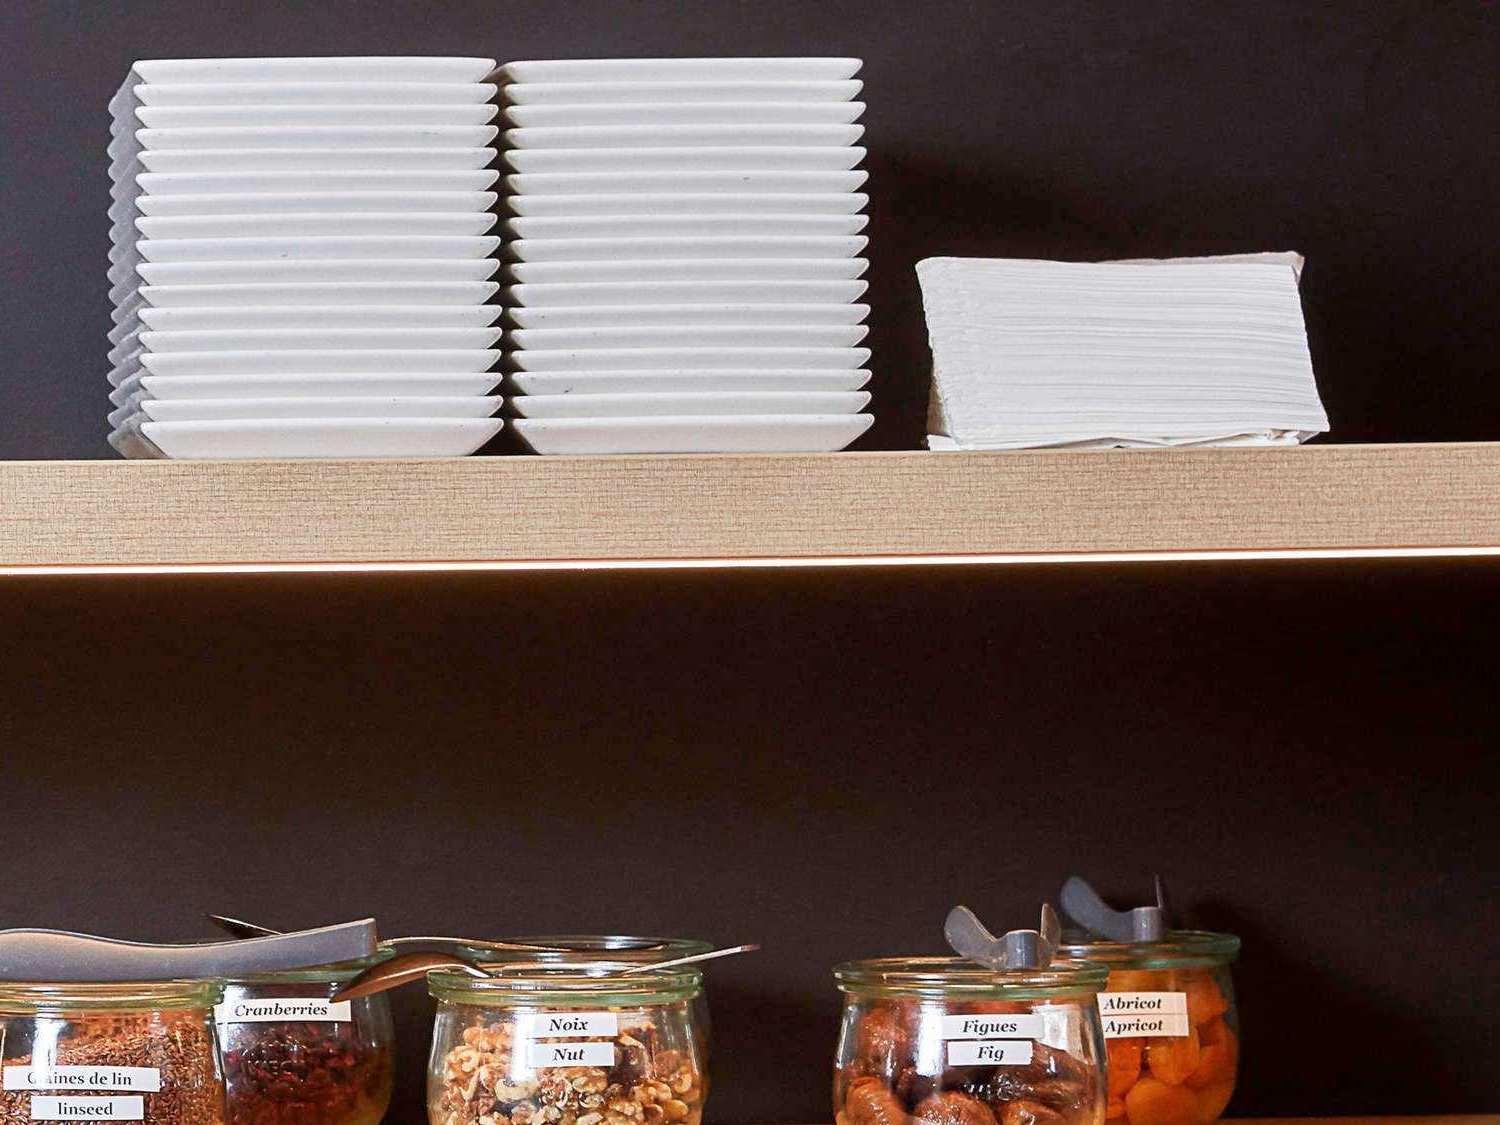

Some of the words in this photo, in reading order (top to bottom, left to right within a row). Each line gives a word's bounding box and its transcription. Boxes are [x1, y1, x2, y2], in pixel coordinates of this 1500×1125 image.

[235, 1003, 328, 1017] Cranberries
[1104, 996, 1162, 1010] Abricot
[549, 1017, 589, 1031] Noix
[962, 1020, 1017, 1036] Figues
[1105, 1020, 1163, 1035] Apricot
[554, 1048, 585, 1061] Nut
[977, 1045, 1004, 1062] Fig
[28, 1071, 85, 1085] Gaines
[89, 1072, 108, 1085] de
[112, 1073, 132, 1085] lin
[58, 1102, 113, 1115] linseed
